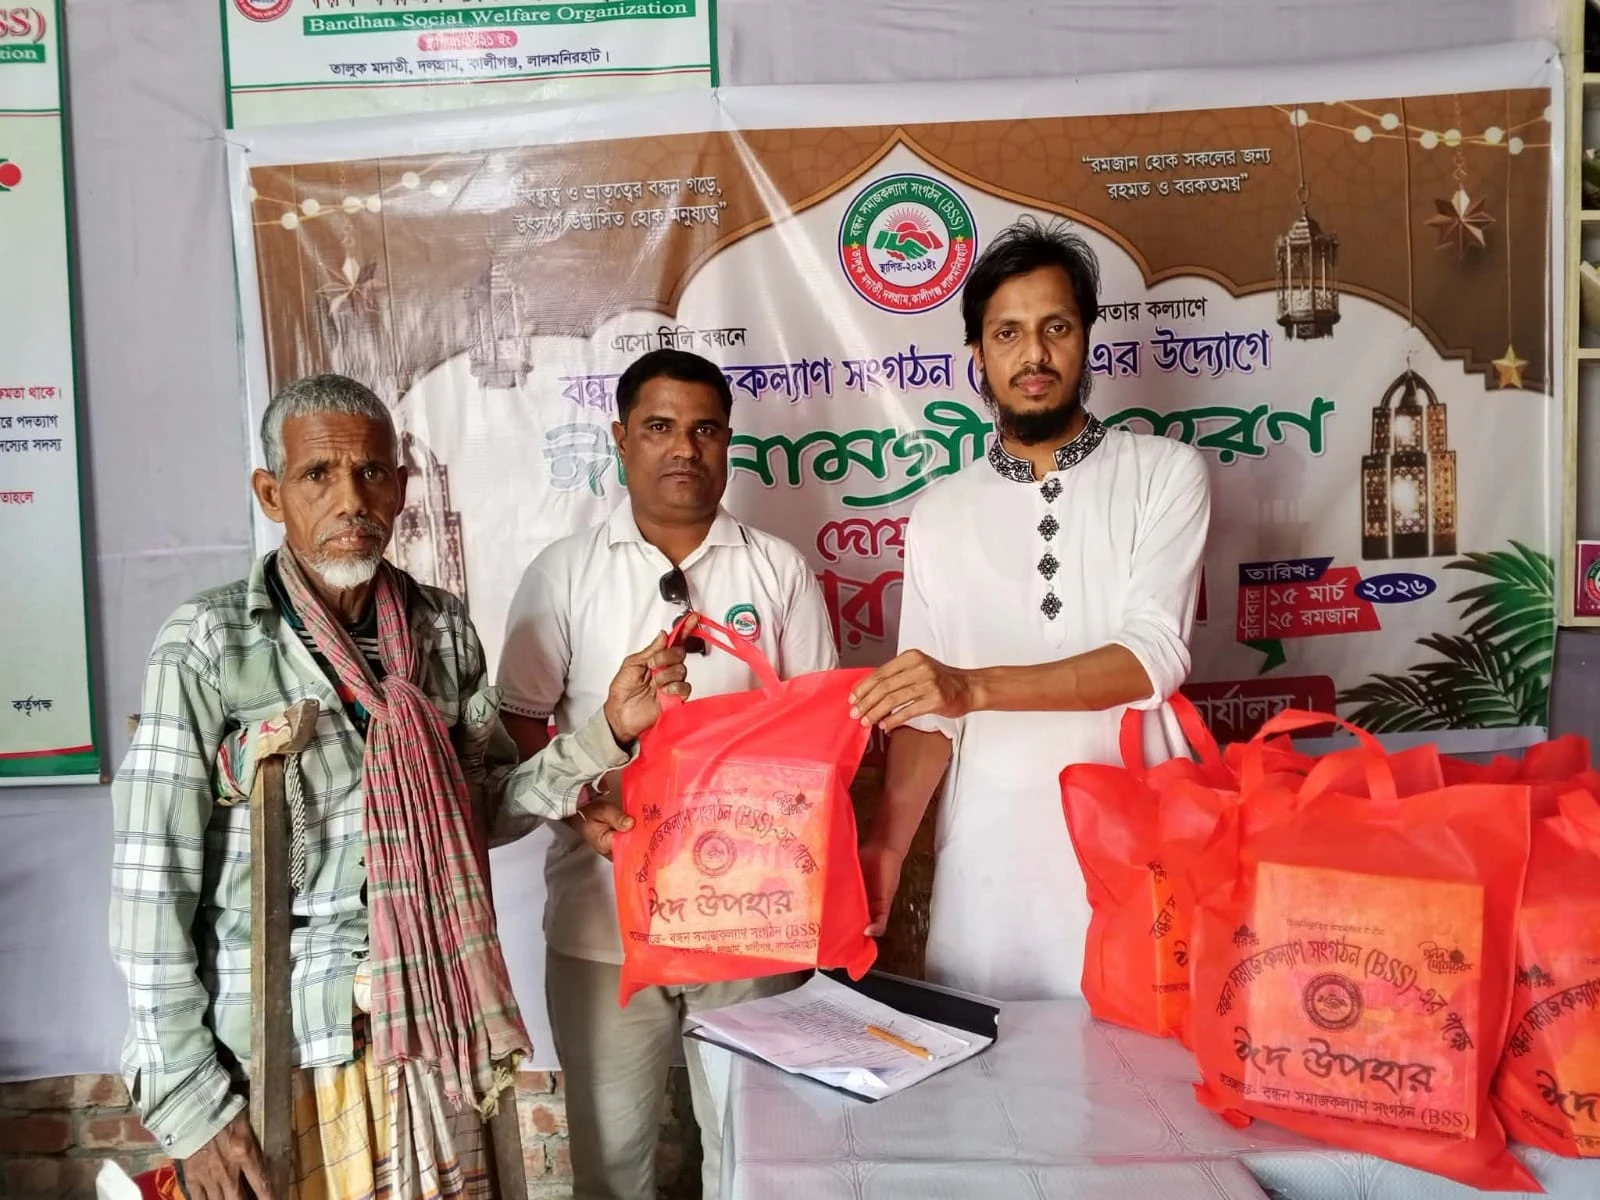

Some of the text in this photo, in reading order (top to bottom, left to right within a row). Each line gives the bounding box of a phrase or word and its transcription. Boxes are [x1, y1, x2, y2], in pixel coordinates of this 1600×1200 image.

[309, 16, 397, 32] Bandhan
[402, 11, 464, 28] Social
[473, 8, 551, 26] Welfare
[556, 1, 688, 23] Organization
[328, 61, 369, 78] তালুক
[371, 56, 414, 75] মদাতী,
[525, 48, 602, 68] লালমনিরহাট
[1081, 148, 1272, 174] “রমজান হোক সকলের জন্য
[567, 186, 579, 201] ও
[583, 182, 643, 208] ভ্রাতৃত্বের
[648, 178, 681, 199] বন্ধন
[686, 176, 723, 199] গড়ে,
[1105, 182, 1151, 200] রহমত
[1156, 181, 1169, 196] ও
[567, 208, 625, 230] উদ্ভাসিত
[630, 210, 666, 228] হোক
[850, 181, 965, 238] বন্ধন সমাজকল্যাণ সংগঠন (BSS)
[1097, 297, 1208, 324] বতার কল্যাণে
[610, 326, 748, 353] এসো মিলি বন্ধনে
[1150, 328, 1272, 379] উদ্যোগে
[28, 386, 56, 401] থাকে
[557, 374, 618, 414] বন্ধ
[722, 356, 834, 403] কল্যাণ
[842, 344, 957, 394] সংগঠন
[16, 415, 59, 429] পদত্যাগ
[32, 438, 63, 452] সদস্য
[1245, 562, 1316, 582] তারিখ:
[1268, 577, 1429, 606] ১৫ মার্চ ২০২৬
[1239, 588, 1262, 639] রবিবার
[1267, 606, 1361, 630] ২৫ রমজান
[649, 885, 794, 923] ঈদ উপহার
[785, 921, 822, 939] (BSS)
[1229, 939, 1305, 988] সমাজকল্যাণ
[1307, 935, 1363, 966] সংগঠন
[1234, 1025, 1437, 1096] ঈদ উপহার
[1262, 1086, 1291, 1102] বন্ধন
[1294, 1090, 1369, 1115] সমাজকল্যাণ
[1372, 1099, 1416, 1119] সংগঠন
[1420, 1107, 1471, 1132] (BSS)
